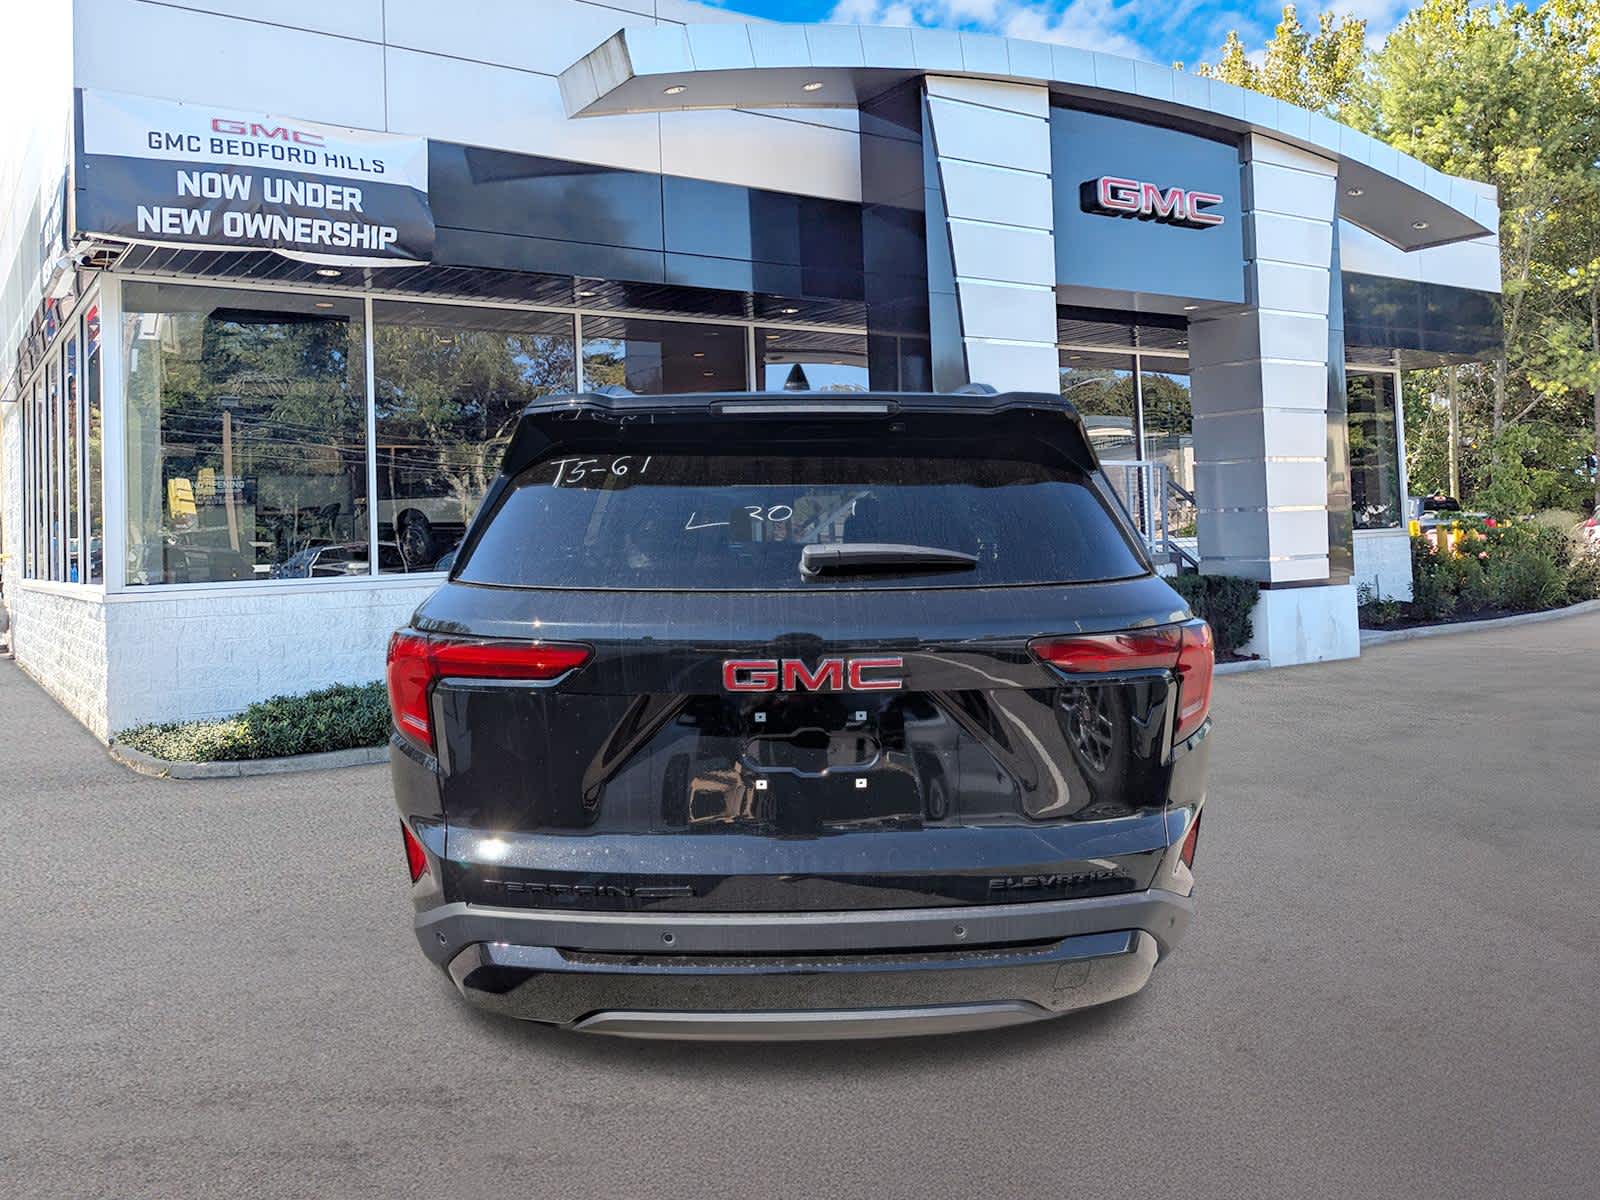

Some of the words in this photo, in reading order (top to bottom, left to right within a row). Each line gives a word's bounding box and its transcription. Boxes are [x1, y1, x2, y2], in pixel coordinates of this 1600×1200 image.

[148, 131, 201, 152] GMC
[210, 138, 317, 165] BEDFORD
[324, 153, 385, 174] HILLS
[211, 118, 326, 148] GMC
[176, 170, 252, 201] NOW
[263, 177, 363, 213] UNDER
[1097, 176, 1225, 225] GMC
[136, 205, 212, 236] NEW
[223, 211, 398, 250] OWNERSHIP
[722, 657, 904, 692] GMC
